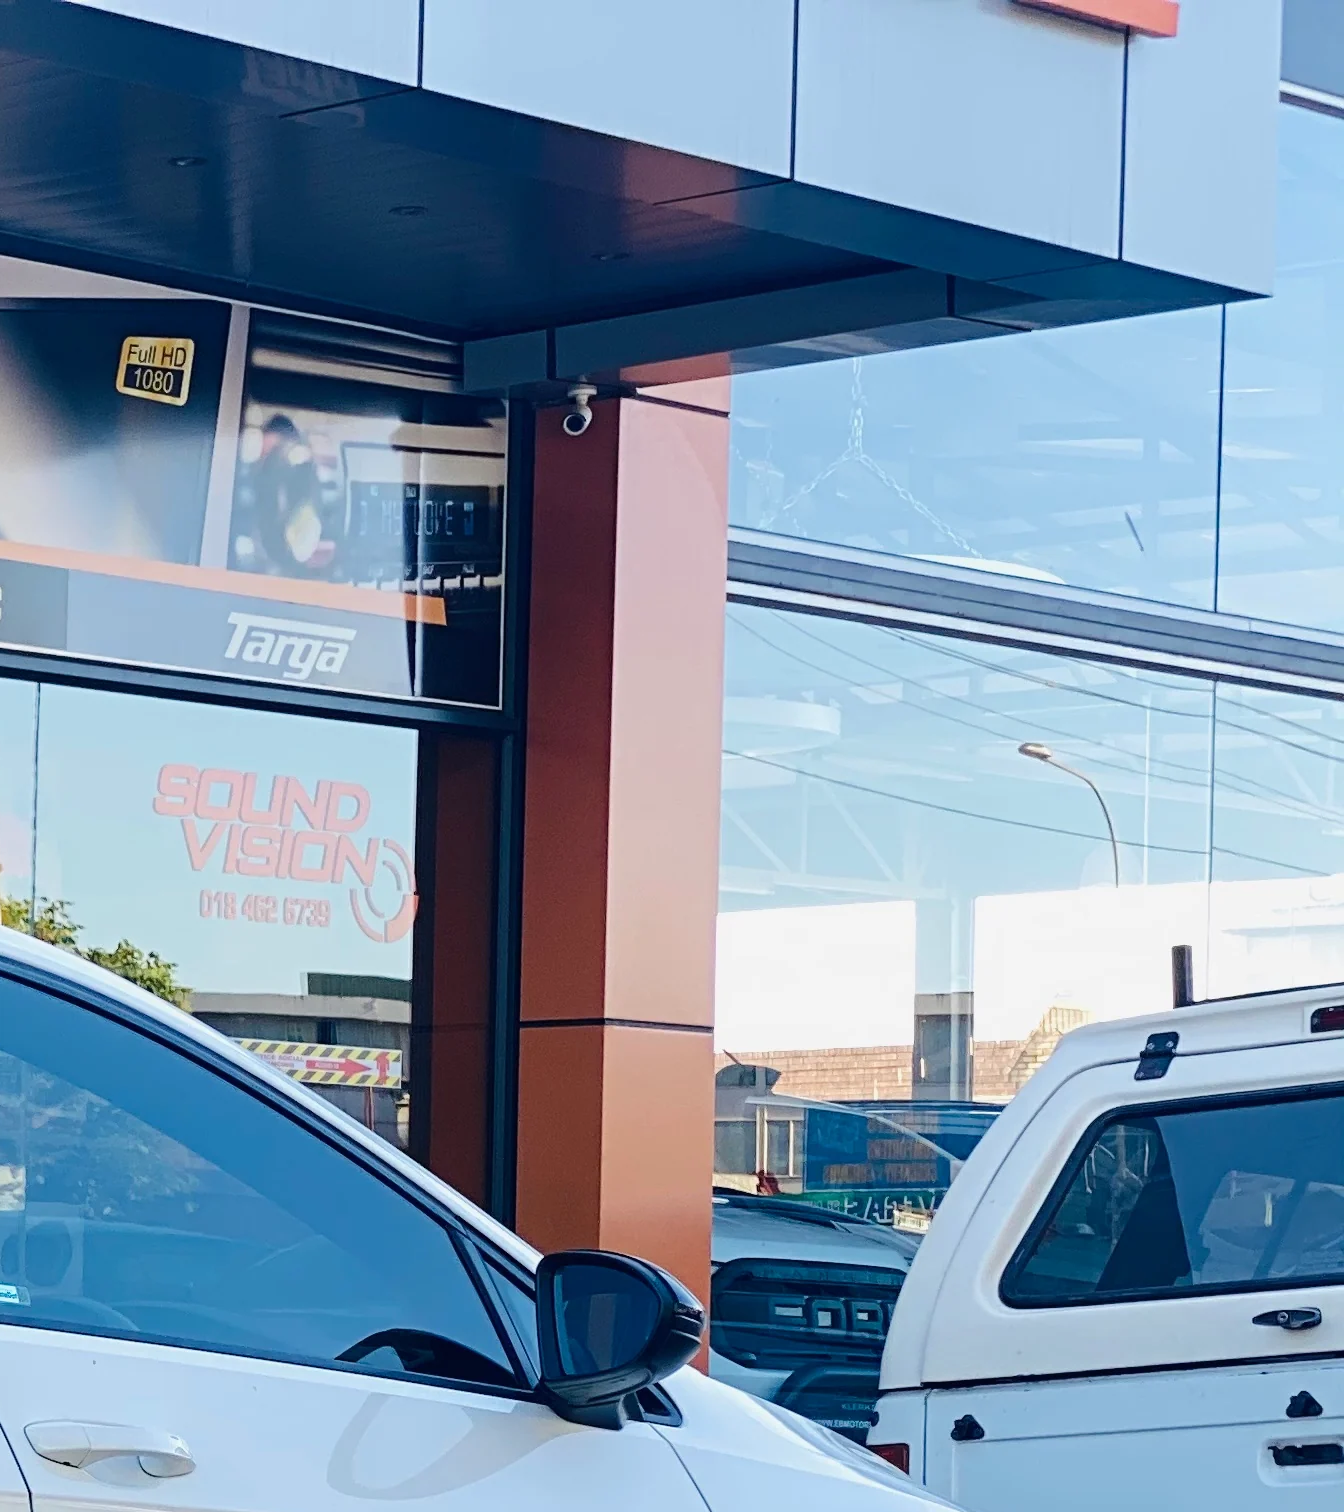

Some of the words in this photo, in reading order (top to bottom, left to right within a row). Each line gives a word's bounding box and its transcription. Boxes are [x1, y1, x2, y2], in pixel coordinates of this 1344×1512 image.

[127, 344, 157, 364] Full
[161, 346, 187, 368] HD
[134, 367, 174, 394] 1080
[224, 611, 358, 681] Targa
[152, 763, 371, 834] SOUND
[180, 818, 380, 887] VISION
[200, 889, 237, 920] 018
[241, 893, 278, 923] 462
[283, 896, 331, 928] 6739
